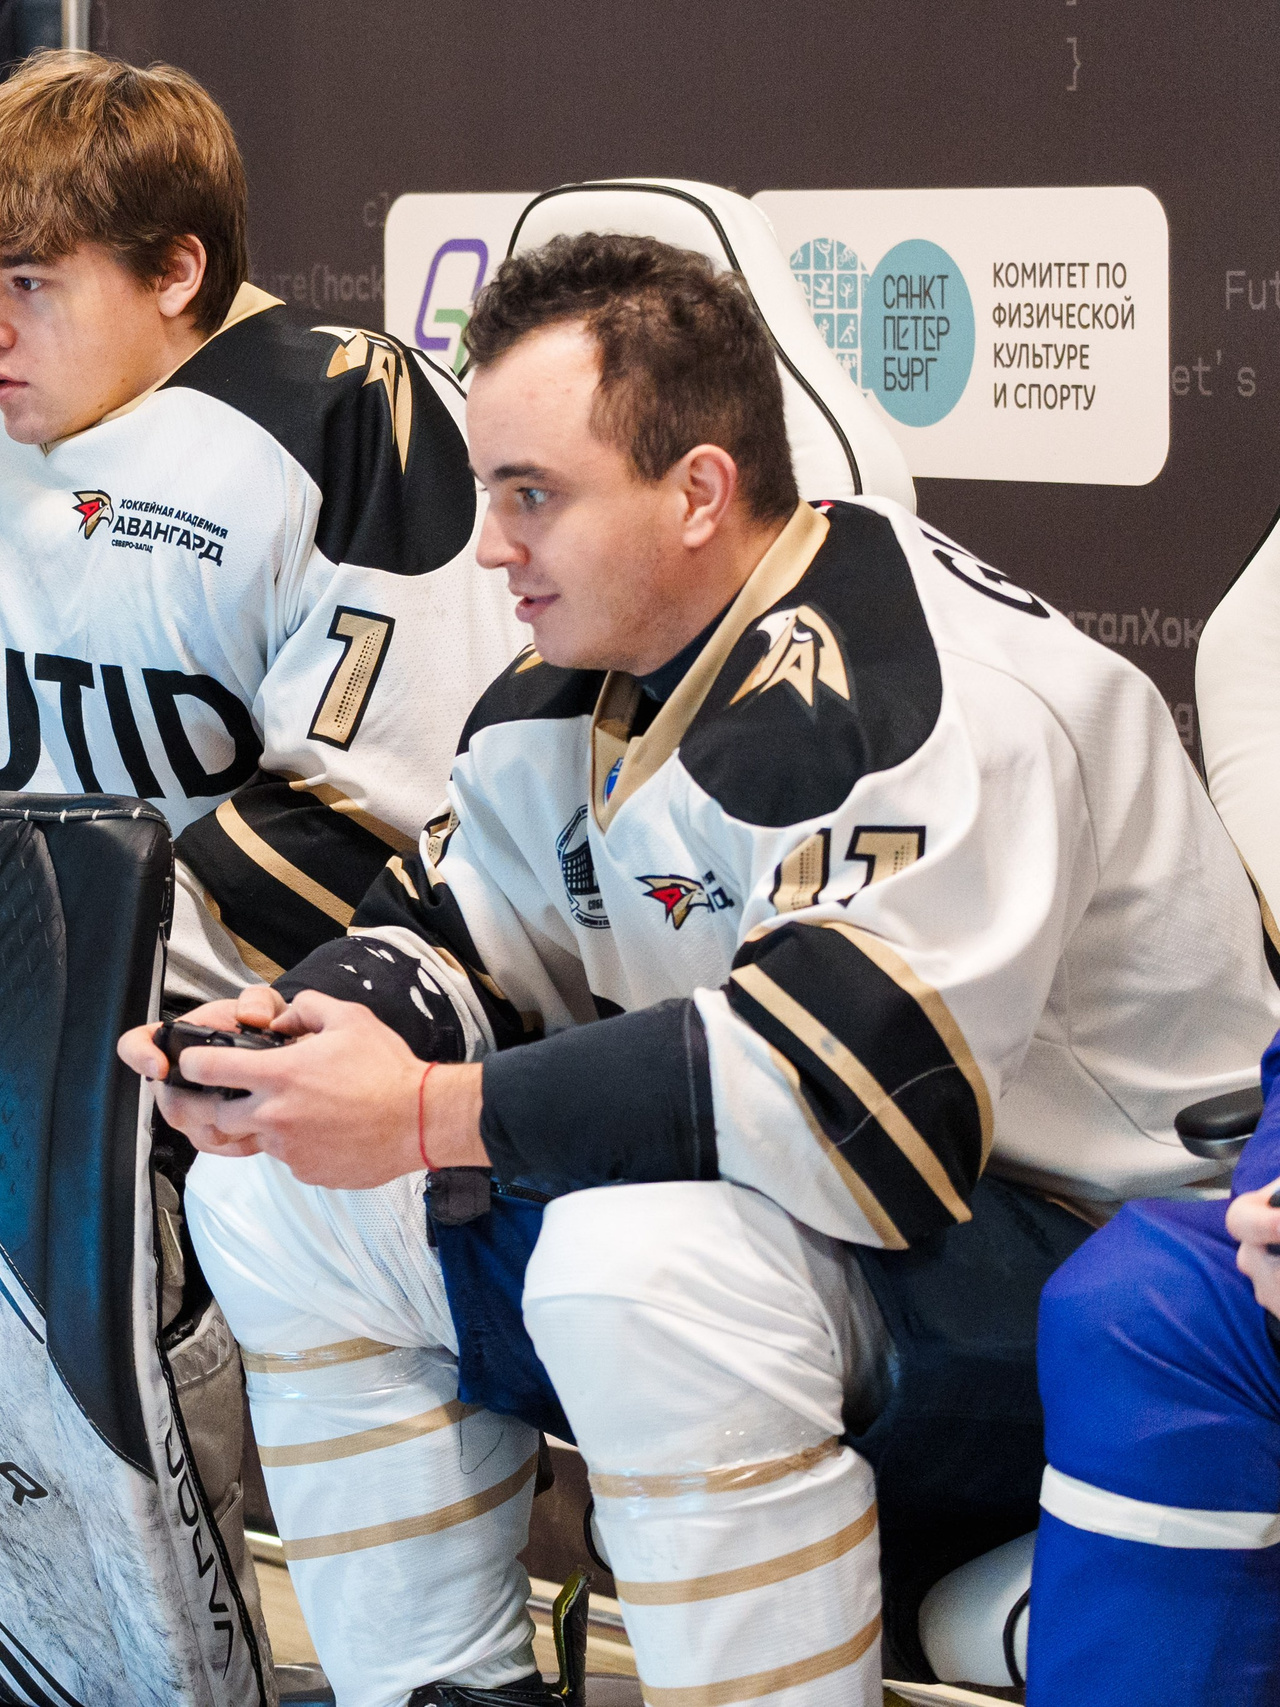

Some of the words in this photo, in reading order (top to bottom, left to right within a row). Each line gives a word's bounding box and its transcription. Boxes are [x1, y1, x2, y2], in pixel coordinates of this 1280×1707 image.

[882, 274, 949, 311] САНКТ
[992, 262, 1090, 289] КОМИТЕТ
[1096, 262, 1128, 289] ПО
[992, 295, 1135, 331] ФИЗИЧЕСКОЙ
[882, 315, 951, 352] ПЕТЕР
[992, 342, 1090, 370] КУЛЬТУРЕ
[882, 357, 938, 393] БУРГ
[993, 382, 1008, 409] И
[1013, 383, 1097, 411] СПОРТУ
[119, 498, 175, 519] ХОККЕЙНАЯ
[173, 509, 229, 540] АКАДЕМИЯ
[111, 515, 224, 567] АВАНГАРД
[307, 605, 395, 751] 1
